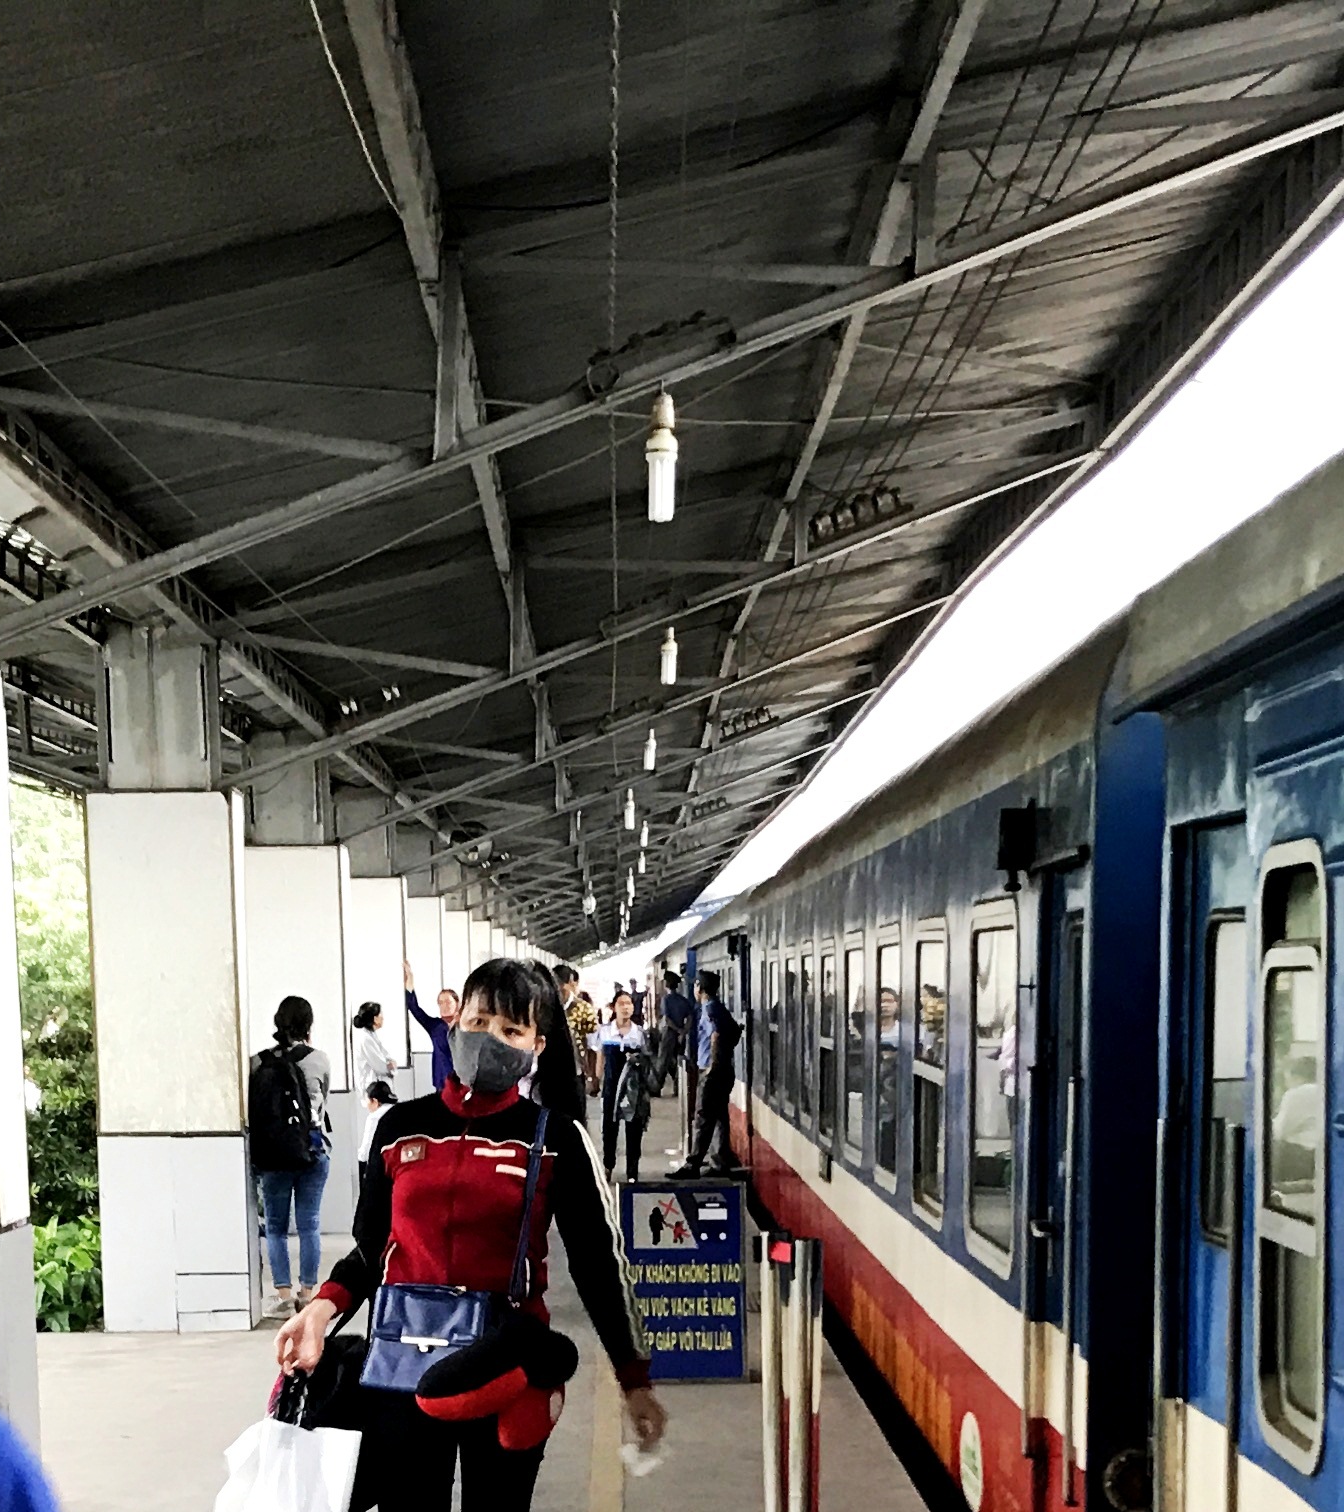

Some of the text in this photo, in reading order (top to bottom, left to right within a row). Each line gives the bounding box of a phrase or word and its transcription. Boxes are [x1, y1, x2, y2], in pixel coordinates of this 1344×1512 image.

[629, 1258, 643, 1284] UÝ
[646, 1258, 676, 1284] KHÁCH
[678, 1258, 710, 1284] KHÔNG
[636, 1297, 649, 1317] HU
